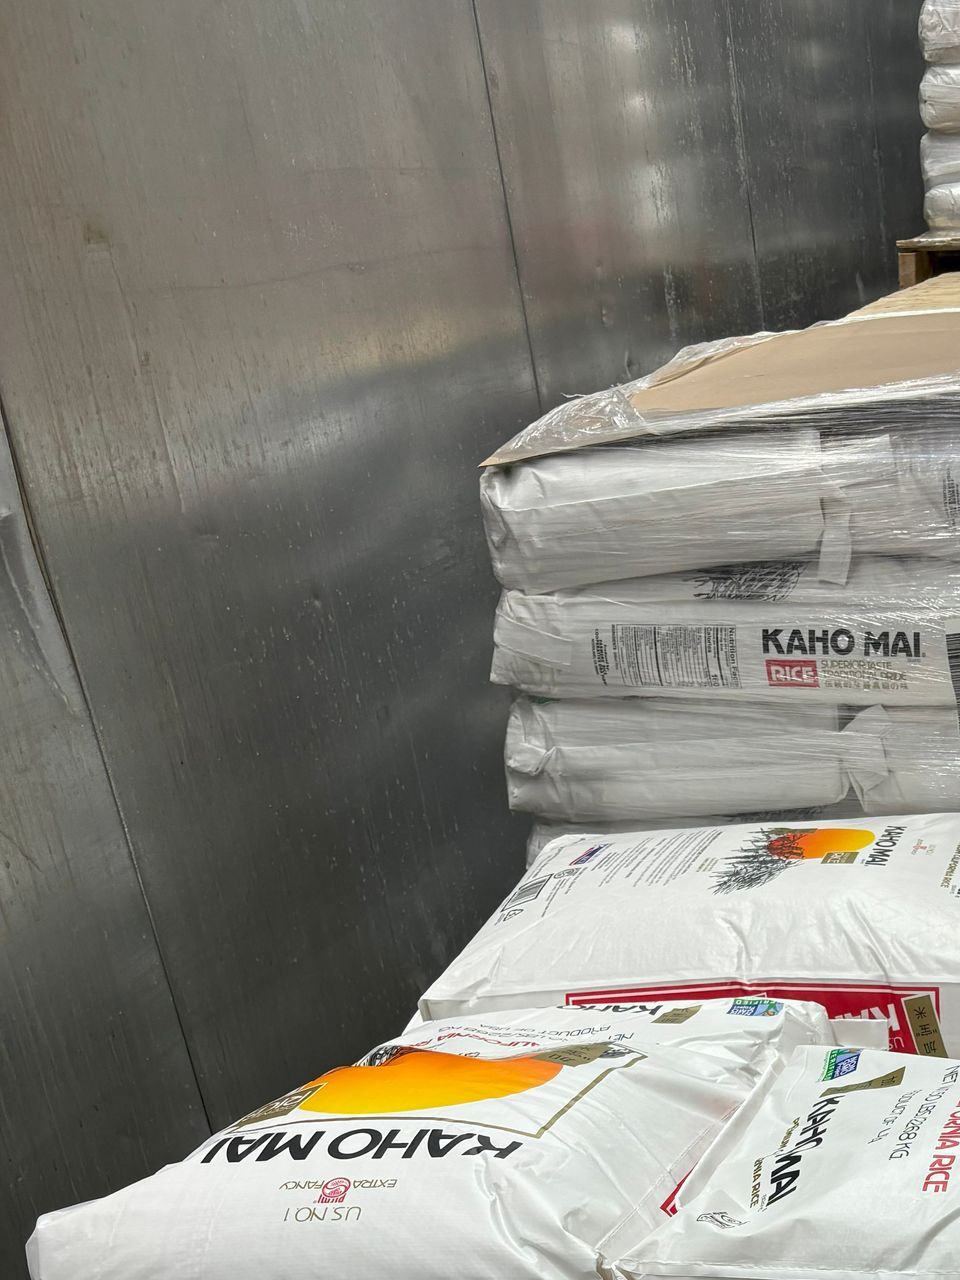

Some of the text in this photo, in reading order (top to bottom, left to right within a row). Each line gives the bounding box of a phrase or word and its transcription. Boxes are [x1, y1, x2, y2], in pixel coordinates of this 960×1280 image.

[762, 629, 920, 657] KAHO MAI
[864, 825, 907, 867] KAHO MAI
[201, 1129, 522, 1164] KAHO MAI
[280, 1178, 398, 1191] EXTRA FANCY
[922, 1154, 956, 1192] RICE
